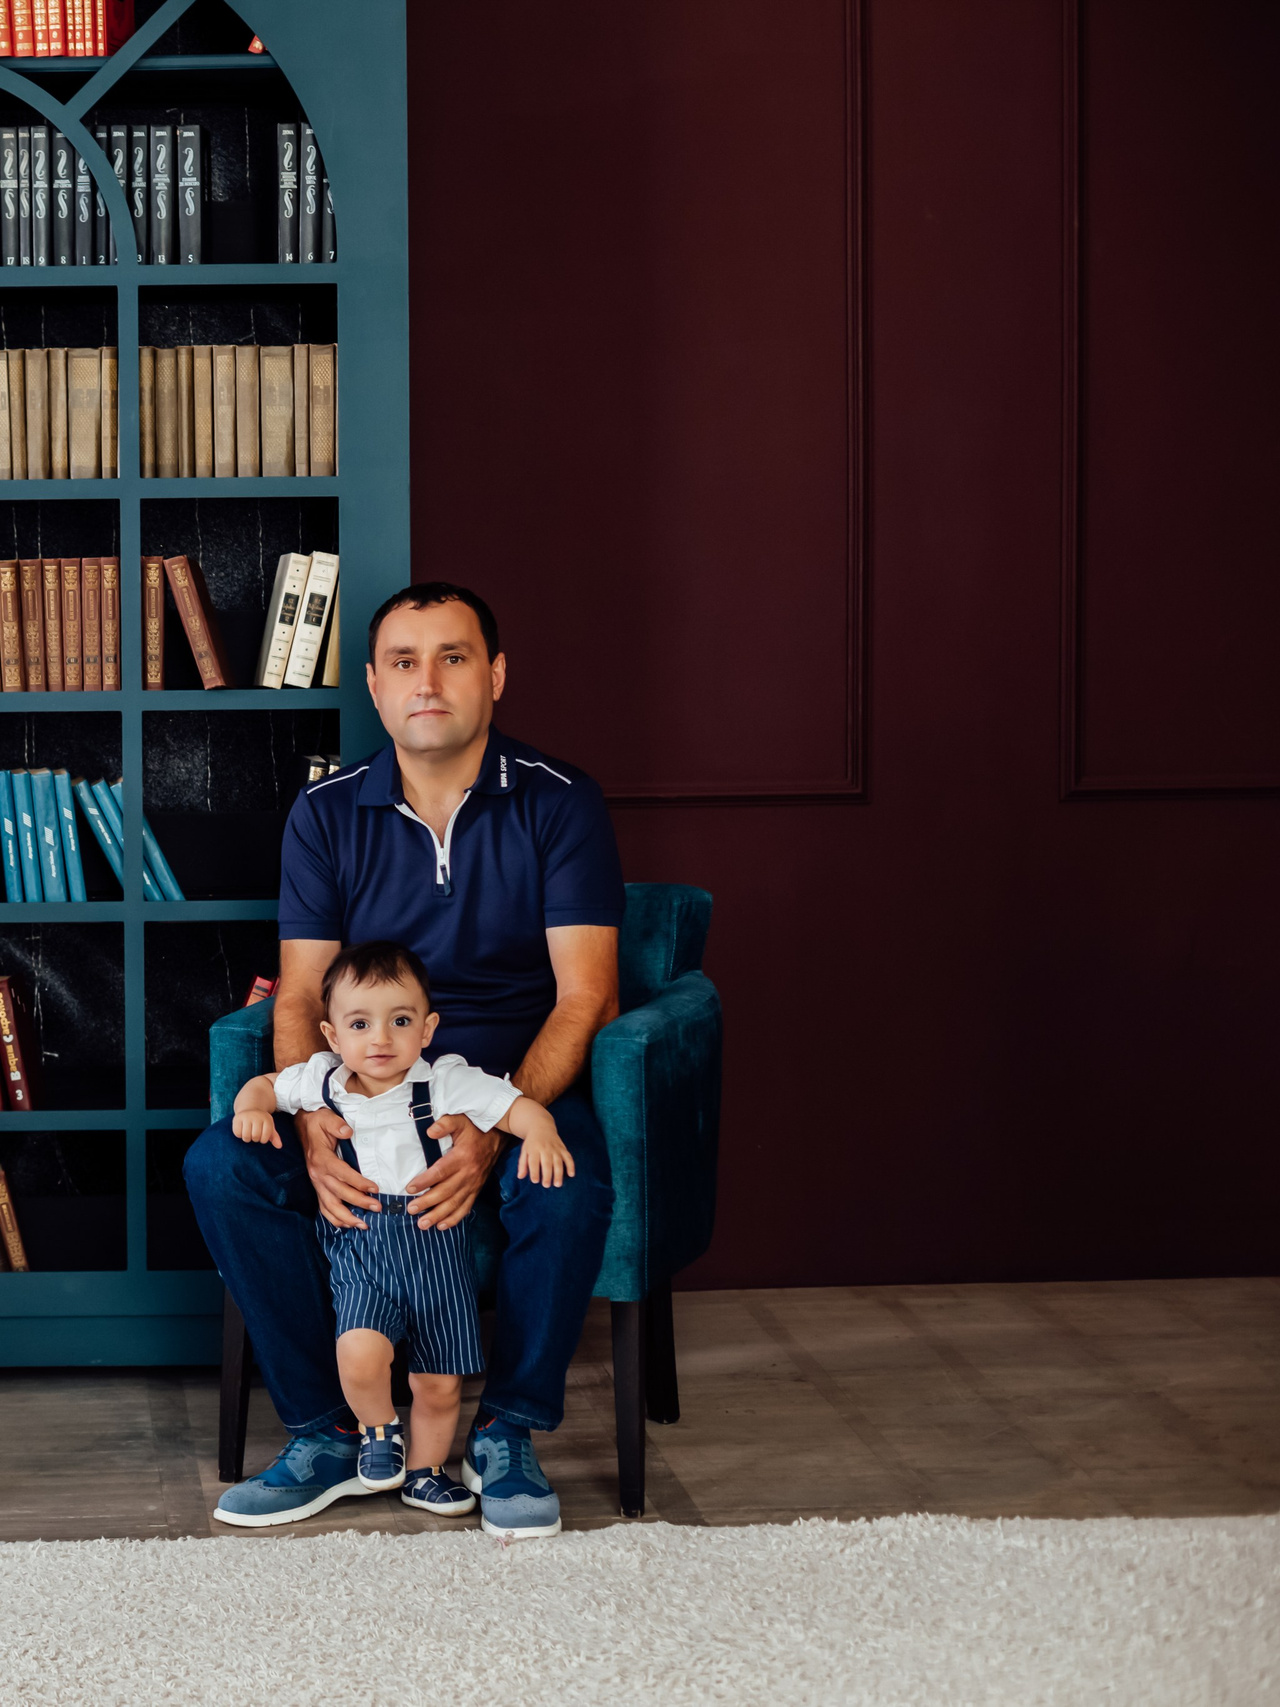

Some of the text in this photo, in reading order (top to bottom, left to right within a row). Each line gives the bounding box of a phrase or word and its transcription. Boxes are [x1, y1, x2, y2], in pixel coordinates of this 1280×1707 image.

[98, 255, 105, 264] 2
[137, 254, 142, 262] 3
[158, 254, 166, 263] 13
[188, 254, 194, 263] 5
[286, 252, 293, 262] 14
[308, 252, 314, 260] 6
[329, 250, 334, 260] 7
[6, 256, 14, 266] 17
[38, 256, 45, 264] 9
[60, 256, 66, 264] 8
[82, 256, 86, 264] 1
[16, 1089, 24, 1100] 3
